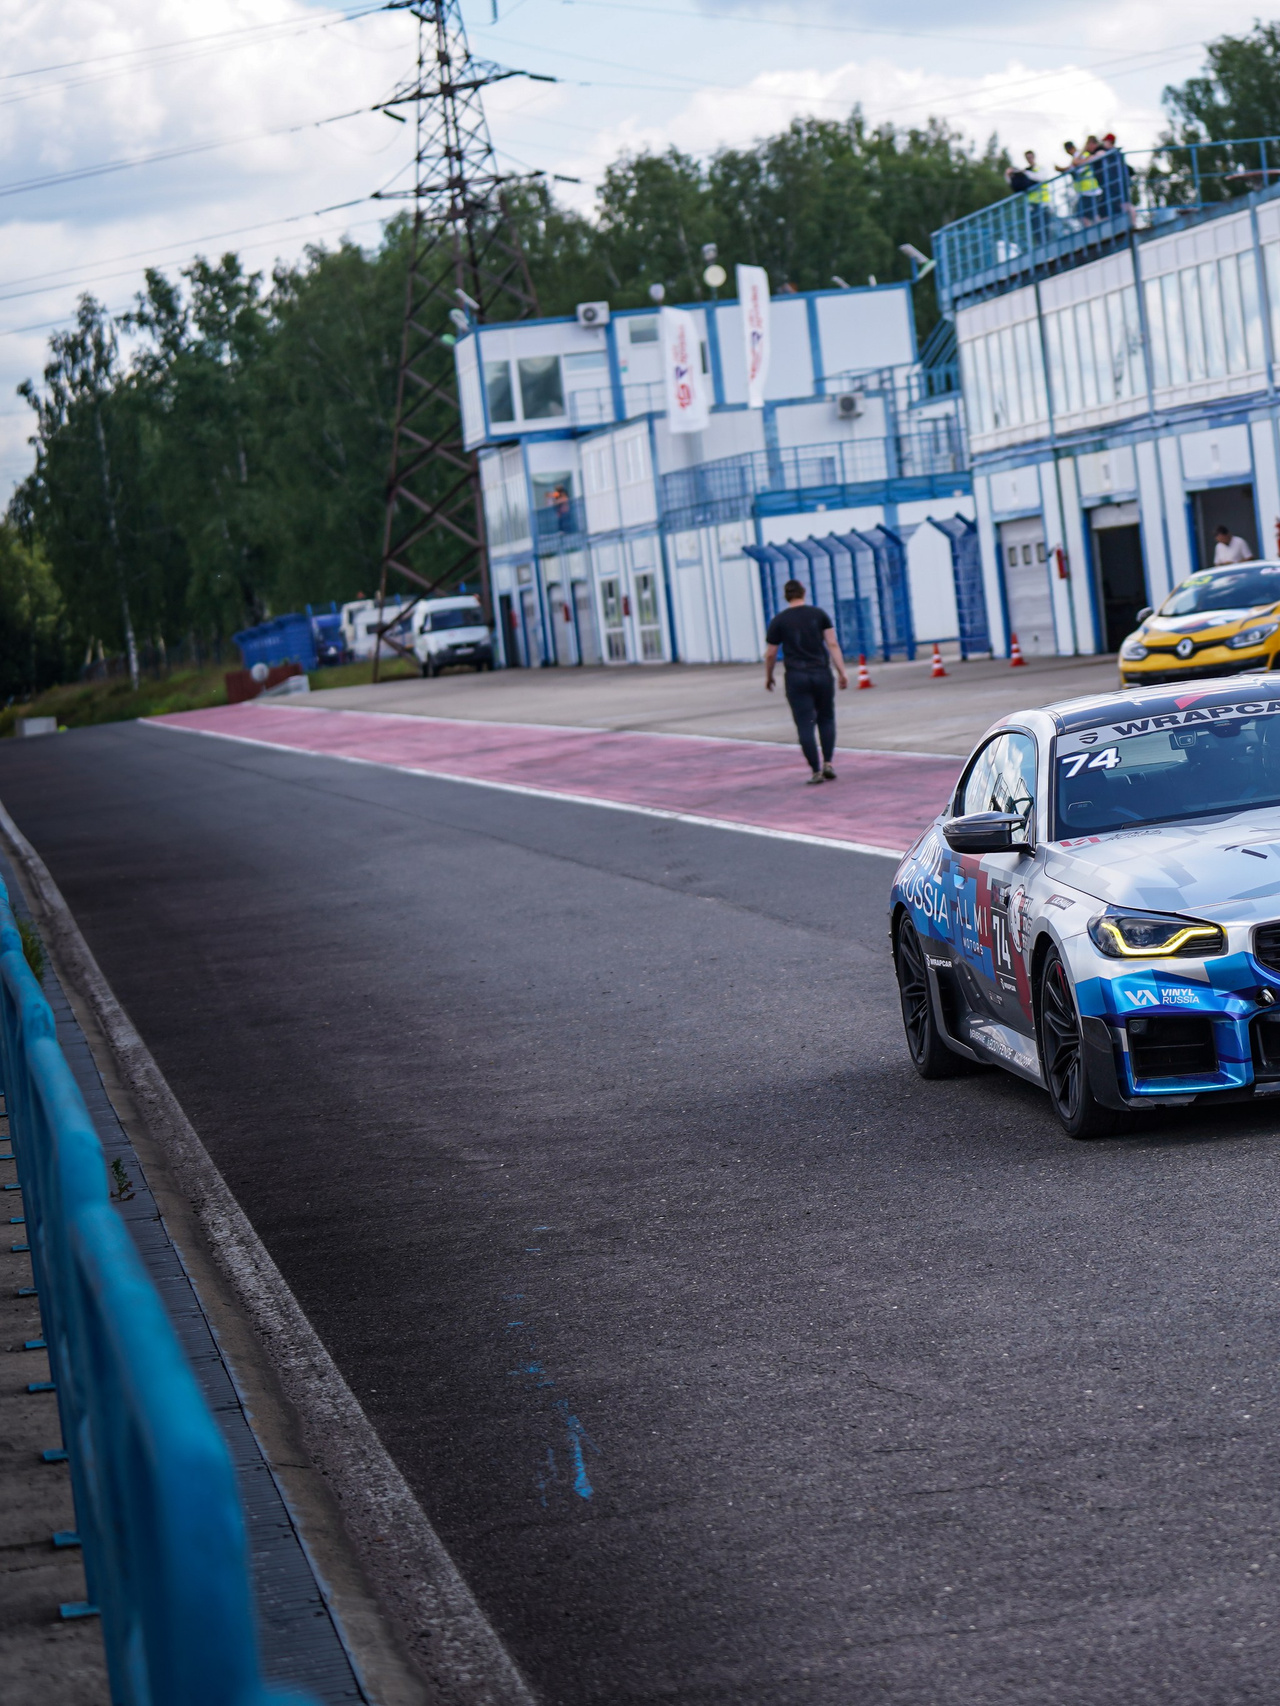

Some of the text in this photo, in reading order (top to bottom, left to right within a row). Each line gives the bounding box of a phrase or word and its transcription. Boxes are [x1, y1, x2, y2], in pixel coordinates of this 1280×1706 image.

[1061, 747, 1120, 779] 74
[898, 864, 950, 929] RUSSIA
[956, 896, 988, 937] ALMI
[992, 914, 1011, 970] 74
[1161, 988, 1194, 996] VINYL
[1162, 996, 1200, 1004] RUSSIA
